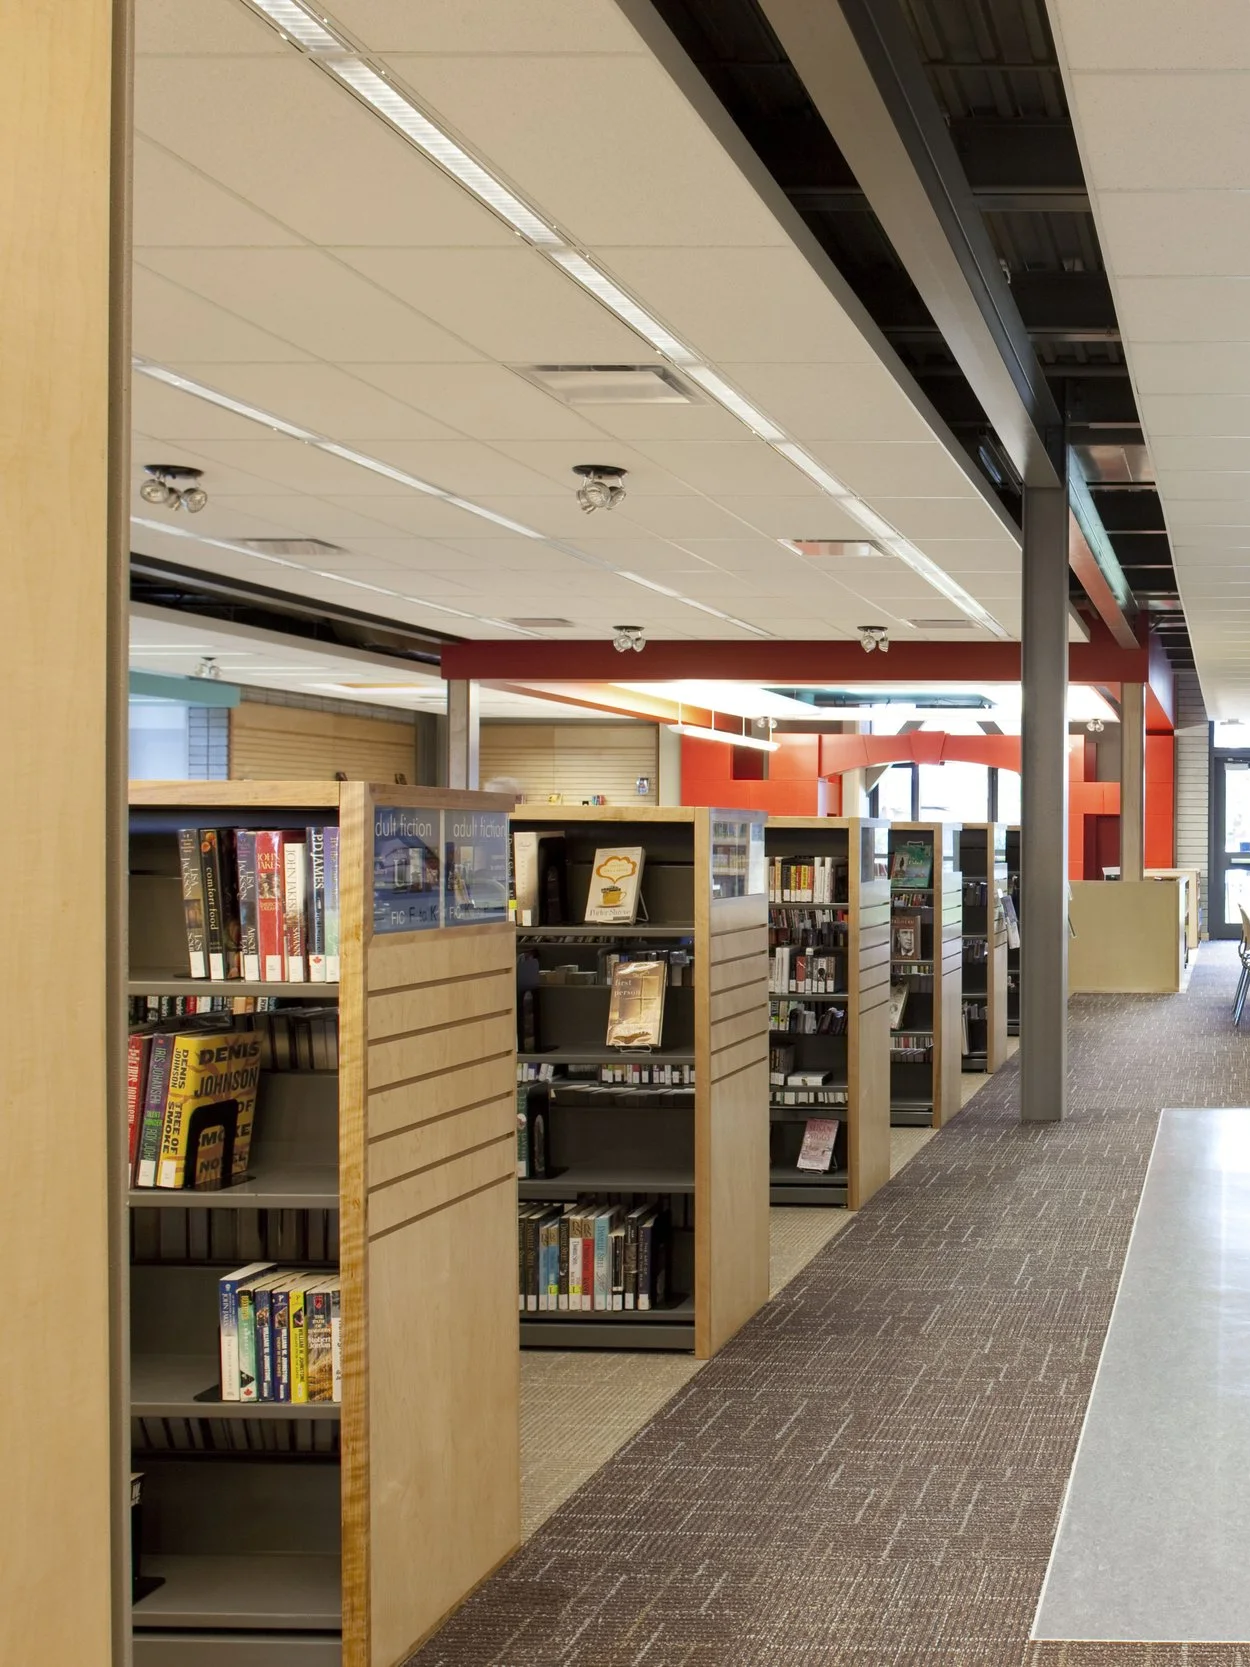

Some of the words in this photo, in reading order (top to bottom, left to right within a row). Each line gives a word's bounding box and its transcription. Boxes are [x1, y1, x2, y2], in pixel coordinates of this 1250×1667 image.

[400, 813, 432, 837] fiction
[453, 816, 477, 837] adult
[480, 816, 506, 838] fiction
[181, 857, 193, 897] JACKSON
[190, 868, 199, 886] LISA
[237, 860, 248, 900] JACKSON
[246, 870, 255, 889] LISA
[287, 849, 297, 881] JOHN
[206, 867, 217, 906] comfort
[210, 908, 219, 931] food
[391, 911, 405, 925] FIC
[154, 1047, 166, 1063] IRIS
[171, 1048, 181, 1089] JOHNSON
[178, 1049, 189, 1090] DENIS
[199, 1041, 261, 1066] DENIS
[150, 1064, 165, 1105] JOHANSEN
[194, 1066, 258, 1099] JOHNSON
[162, 1101, 175, 1154] SMOKE
[173, 1102, 183, 1135] TREE
[170, 1136, 180, 1155] OF
